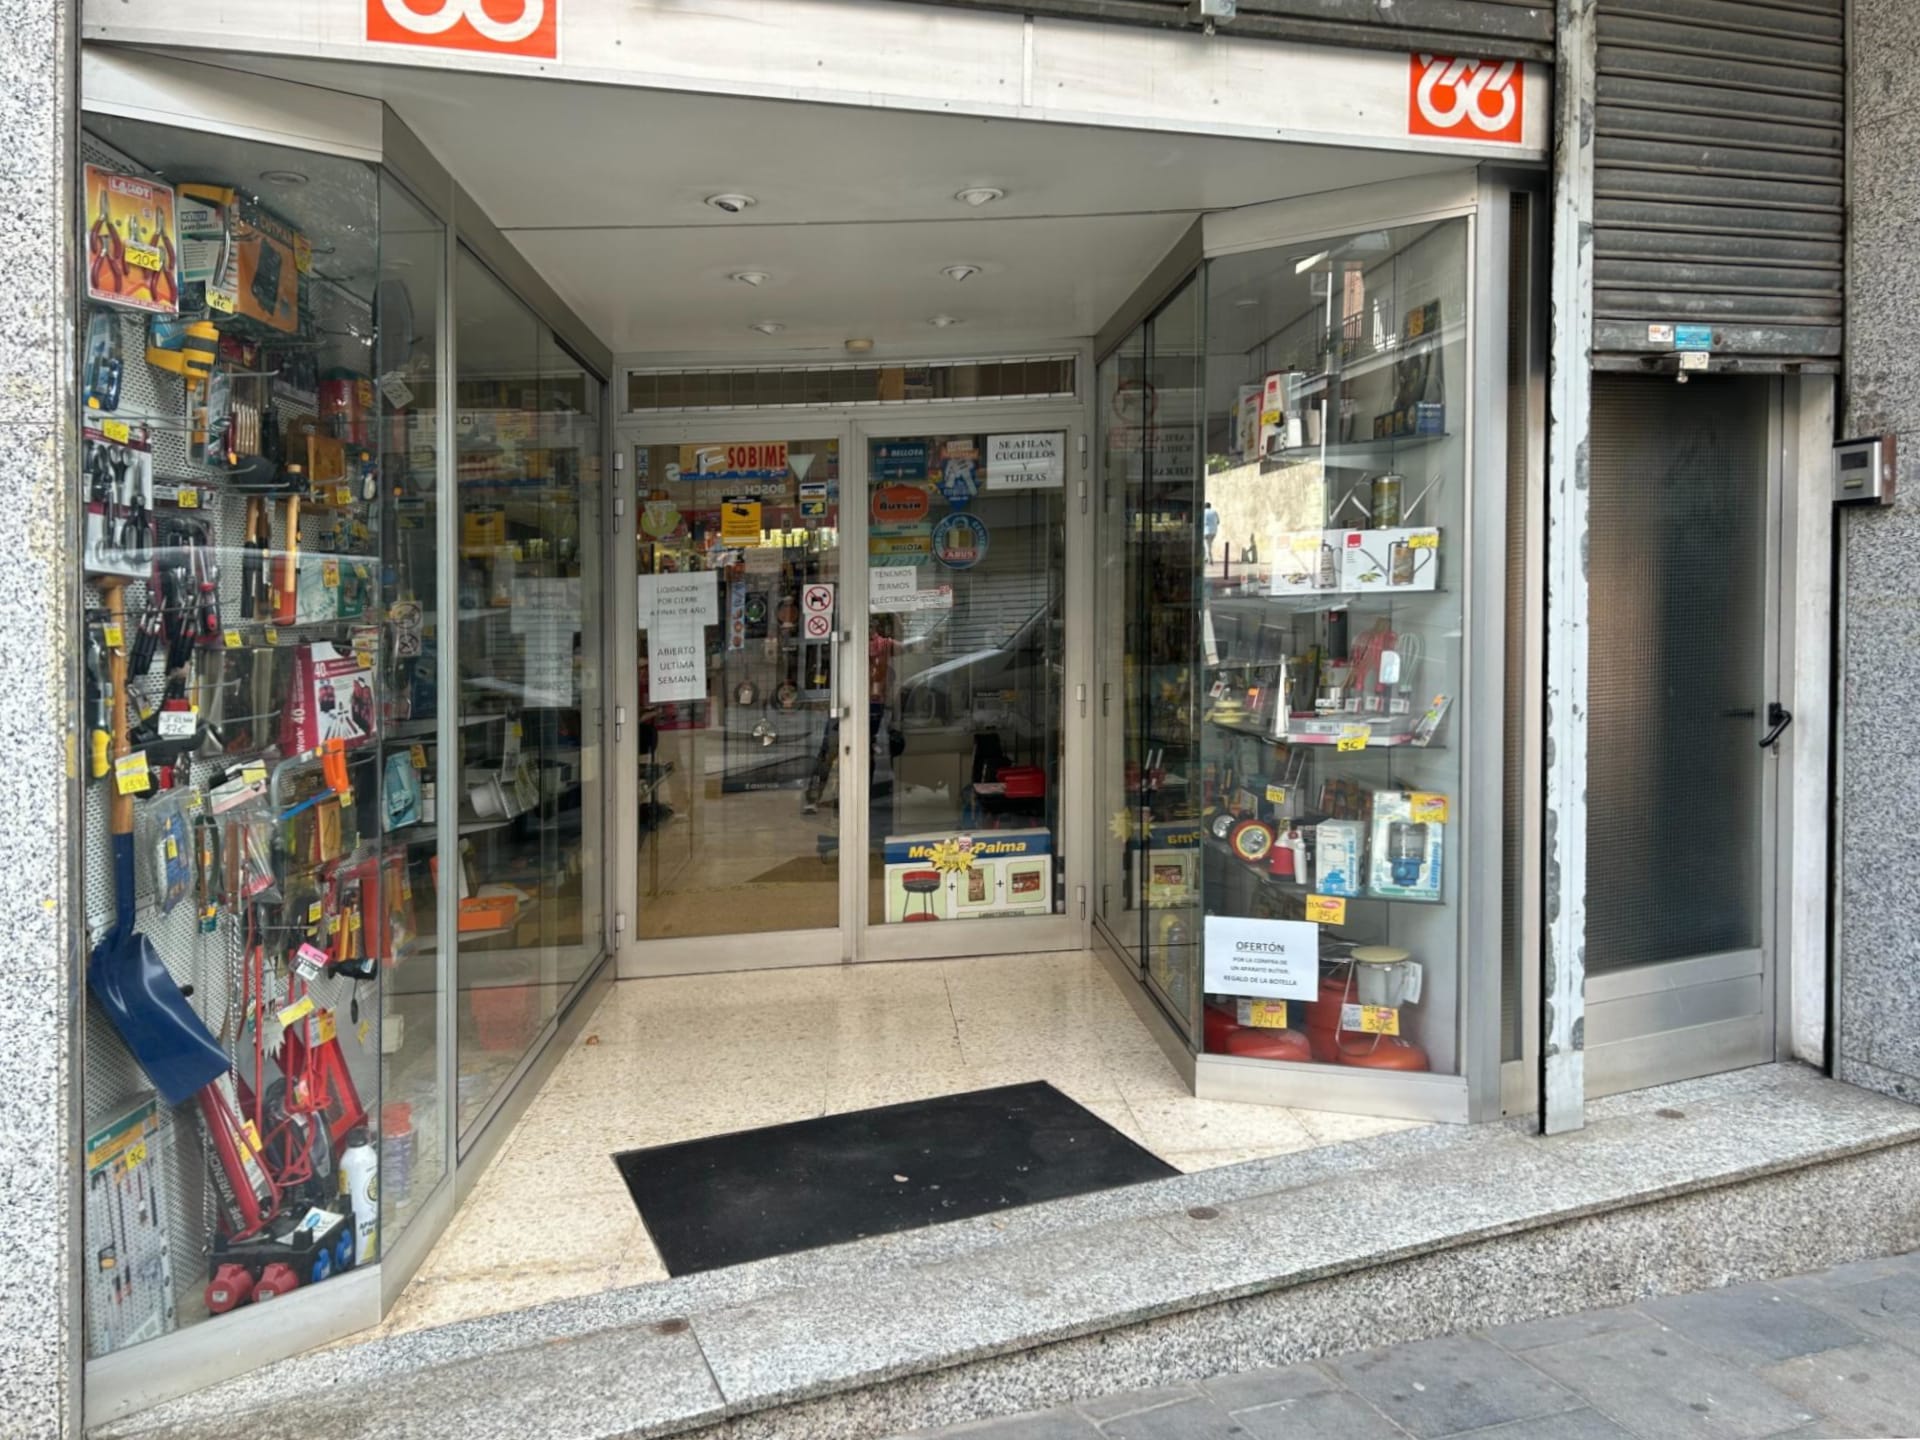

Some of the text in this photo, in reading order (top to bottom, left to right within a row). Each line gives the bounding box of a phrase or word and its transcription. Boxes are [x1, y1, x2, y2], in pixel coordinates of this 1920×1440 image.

[998, 439, 1052, 449] SE AFILAN
[727, 445, 786, 469] SOBIME
[995, 451, 1056, 461] CUCHILLOS
[1004, 473, 1047, 484] TIJERAS
[875, 569, 912, 579] TENEMOS
[877, 582, 910, 591] TERMOS
[678, 607, 688, 615] DE
[657, 646, 696, 657] ABIERTO
[657, 674, 697, 685] SEMANA
[976, 841, 1027, 854] Palma
[1235, 941, 1285, 953] OFERTÓN
[1223, 975, 1248, 983] REGALO
[1250, 976, 1259, 984] DE
[1269, 978, 1297, 986] BOTELLA
[207, 1150, 236, 1203] WRENCH
